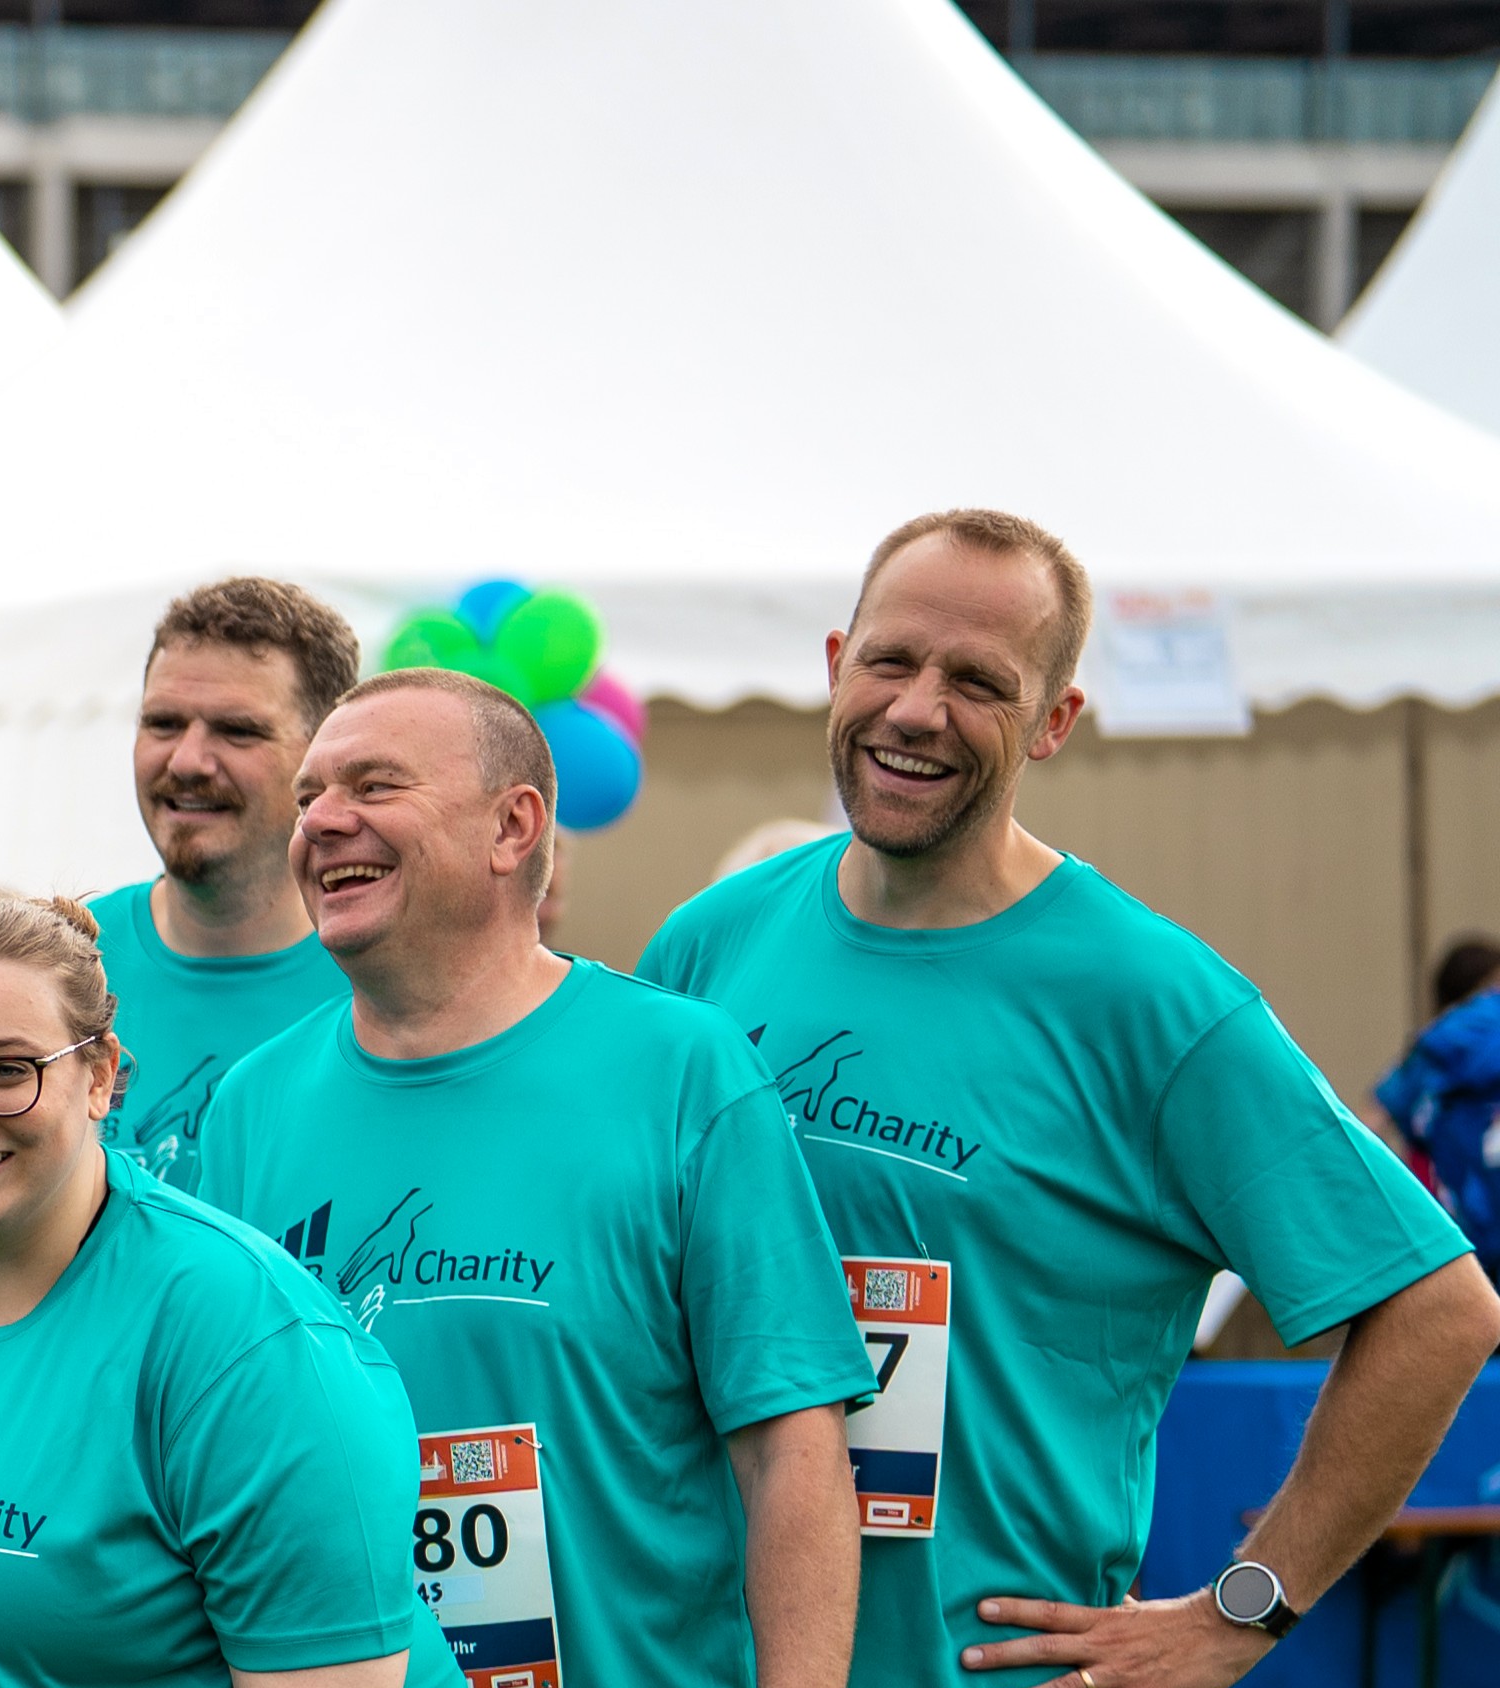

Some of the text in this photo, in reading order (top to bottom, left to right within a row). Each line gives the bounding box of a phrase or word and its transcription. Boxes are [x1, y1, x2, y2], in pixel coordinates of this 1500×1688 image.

[830, 1096, 980, 1170] Charity
[415, 1248, 554, 1292] Charity
[413, 1503, 510, 1573] 80
